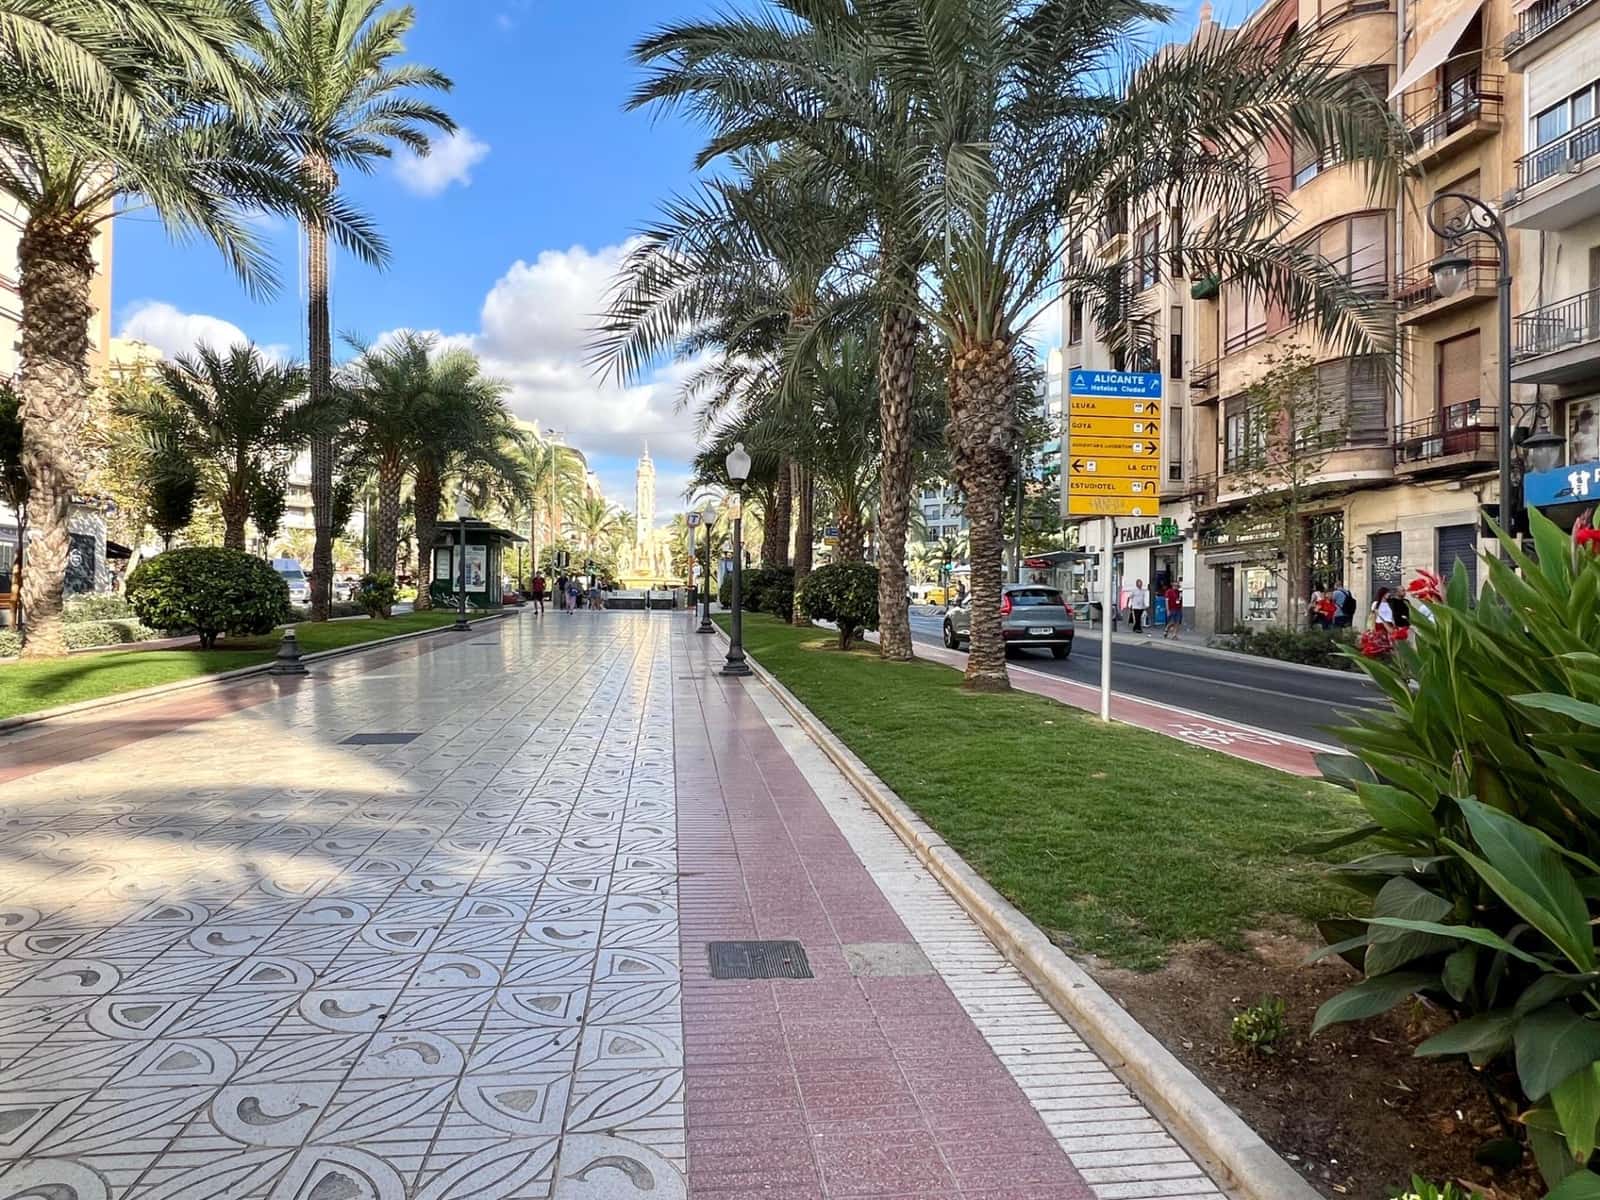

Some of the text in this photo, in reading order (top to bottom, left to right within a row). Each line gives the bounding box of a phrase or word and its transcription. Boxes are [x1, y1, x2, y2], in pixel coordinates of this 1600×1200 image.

[1094, 374, 1145, 385] ALICANTE
[1121, 385, 1146, 393] Ciudad
[1070, 482, 1116, 490] ESTUDIOTEL
